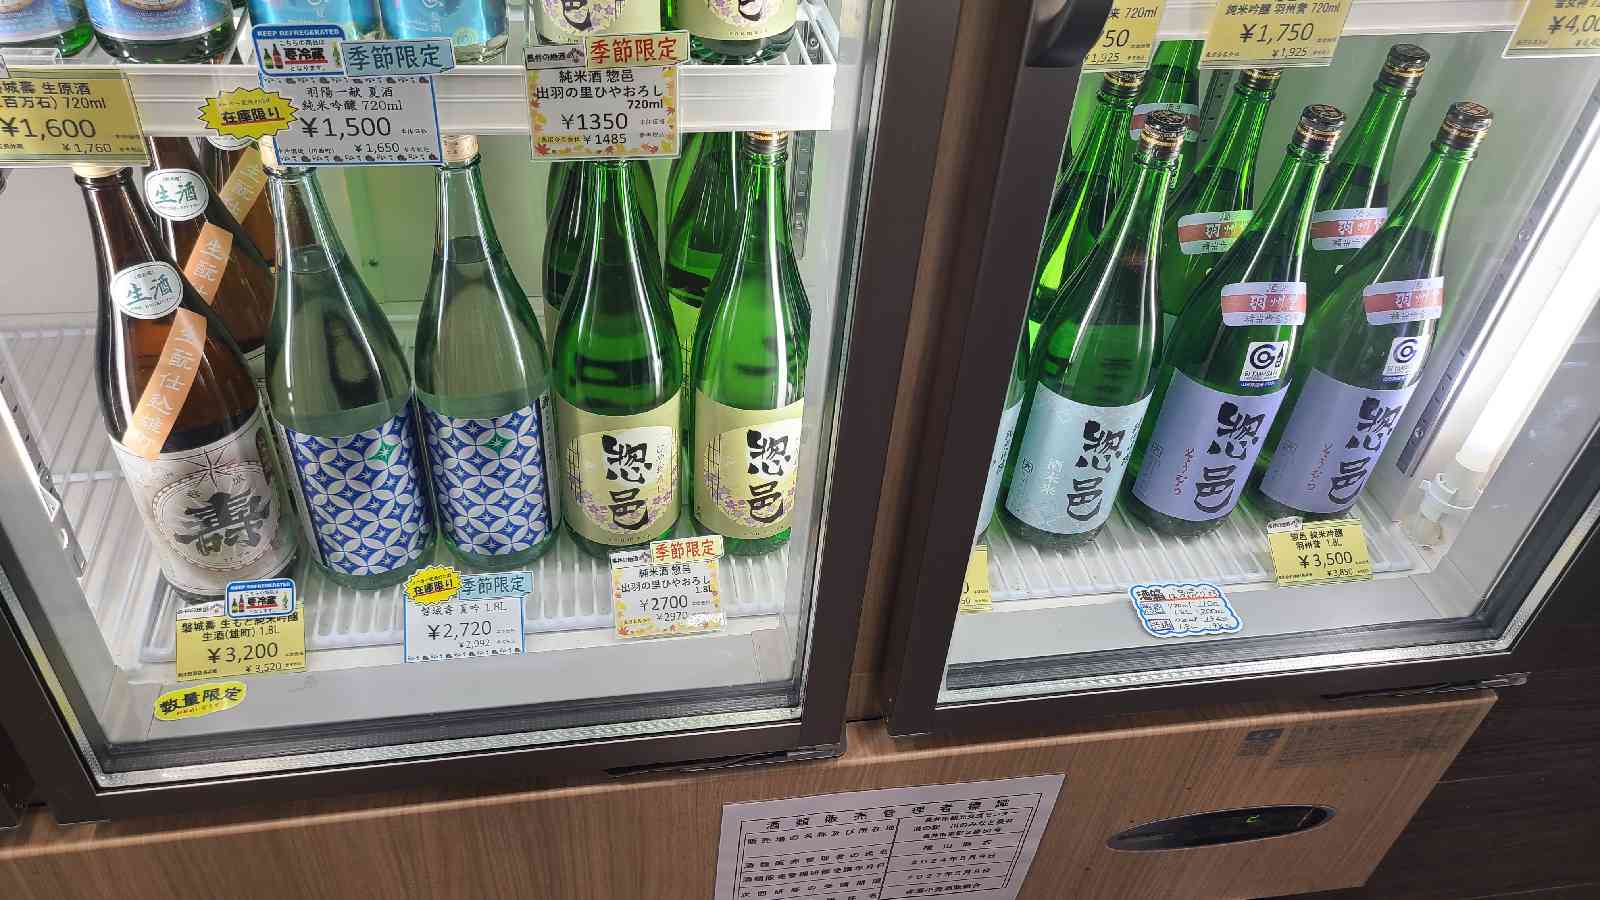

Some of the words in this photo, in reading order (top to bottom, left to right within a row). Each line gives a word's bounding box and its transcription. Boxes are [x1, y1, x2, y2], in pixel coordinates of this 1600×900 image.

[1125, 7, 1159, 19] 720ml
[1311, 2, 1341, 14] 720ml
[1240, 22, 1314, 46] ¥1,750
[283, 47, 326, 60] 要冷蔵
[348, 43, 444, 72] 季節限定
[590, 37, 677, 65] 季節限定
[559, 69, 602, 84] 純米酒
[606, 69, 634, 83] 惣邑
[41, 81, 91, 95] 生原酒
[367, 87, 393, 99] 夏酒
[536, 85, 663, 100] 出羽の里ひやおろし
[61, 96, 107, 110] 720ml
[301, 100, 357, 112] 純米吟醸
[361, 100, 403, 112] 720ml
[627, 99, 664, 110] 720ml
[220, 106, 281, 124] 在庫限り
[561, 112, 629, 131] ¥1350
[1, 116, 97, 142] ¥1,600
[300, 116, 391, 141] ¥1,500
[354, 142, 400, 154] ¥1,650
[583, 133, 628, 146] ¥1485
[62, 143, 112, 155] ¥1,760
[155, 181, 199, 205] 生酒
[127, 273, 174, 306] 生酒
[1193, 401, 1266, 514] 惣邑
[1328, 396, 1404, 505] 惣邑
[746, 429, 792, 524] 惣邑
[1066, 419, 1126, 522] 惣邑
[601, 433, 653, 531] 惣邑
[655, 539, 715, 562] 季節限定
[1298, 551, 1353, 569] ¥3,500
[639, 567, 669, 578] 純米酒
[671, 564, 692, 576] 惣邑
[461, 575, 525, 596] 季節限定
[621, 575, 711, 593] 出羽の里ひやおろし
[695, 584, 713, 594] 1.8L
[640, 594, 688, 612] ¥2700
[260, 625, 280, 637] 1.8L
[427, 620, 492, 641] ¥2,720
[207, 641, 279, 666] ¥3,200
[245, 662, 282, 674] ¥3,520
[160, 686, 243, 715] 数量限定
